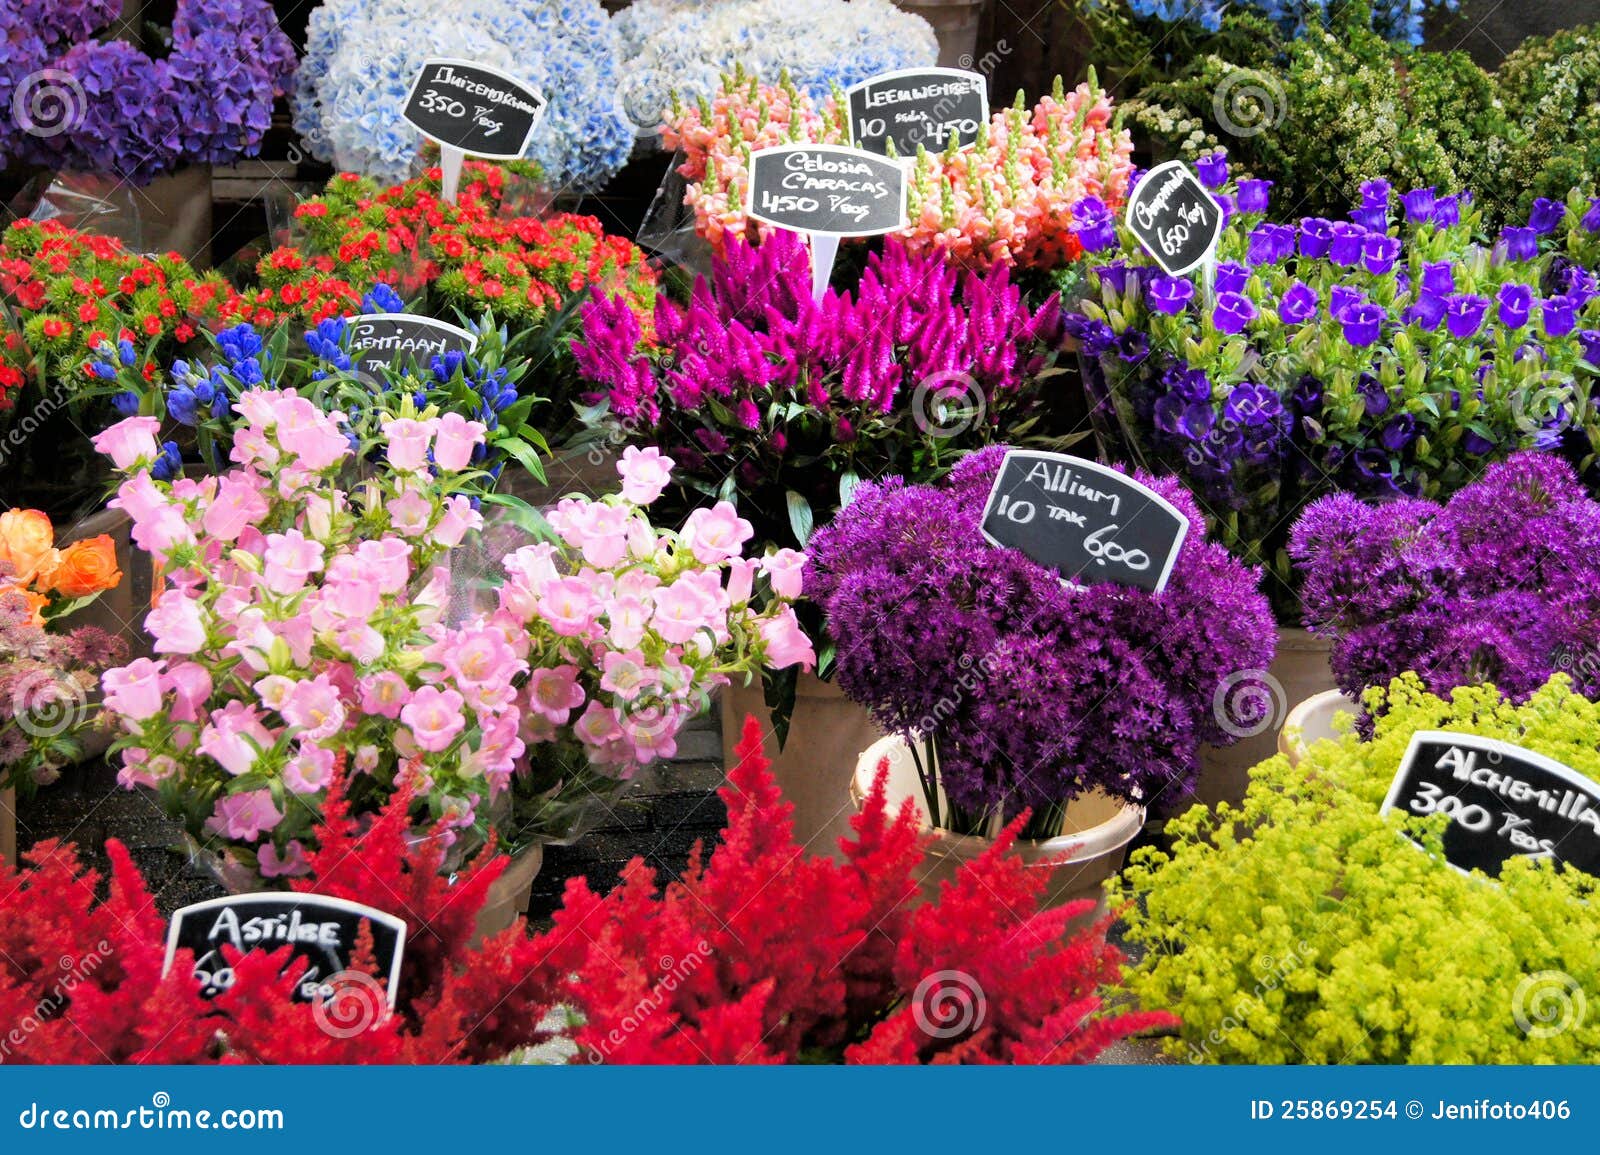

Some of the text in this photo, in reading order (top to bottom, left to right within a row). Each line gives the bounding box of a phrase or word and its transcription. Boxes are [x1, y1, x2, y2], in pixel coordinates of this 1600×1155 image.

[859, 118, 886, 138] 10
[997, 495, 1036, 524] 10
[1045, 504, 1087, 528] TAK
